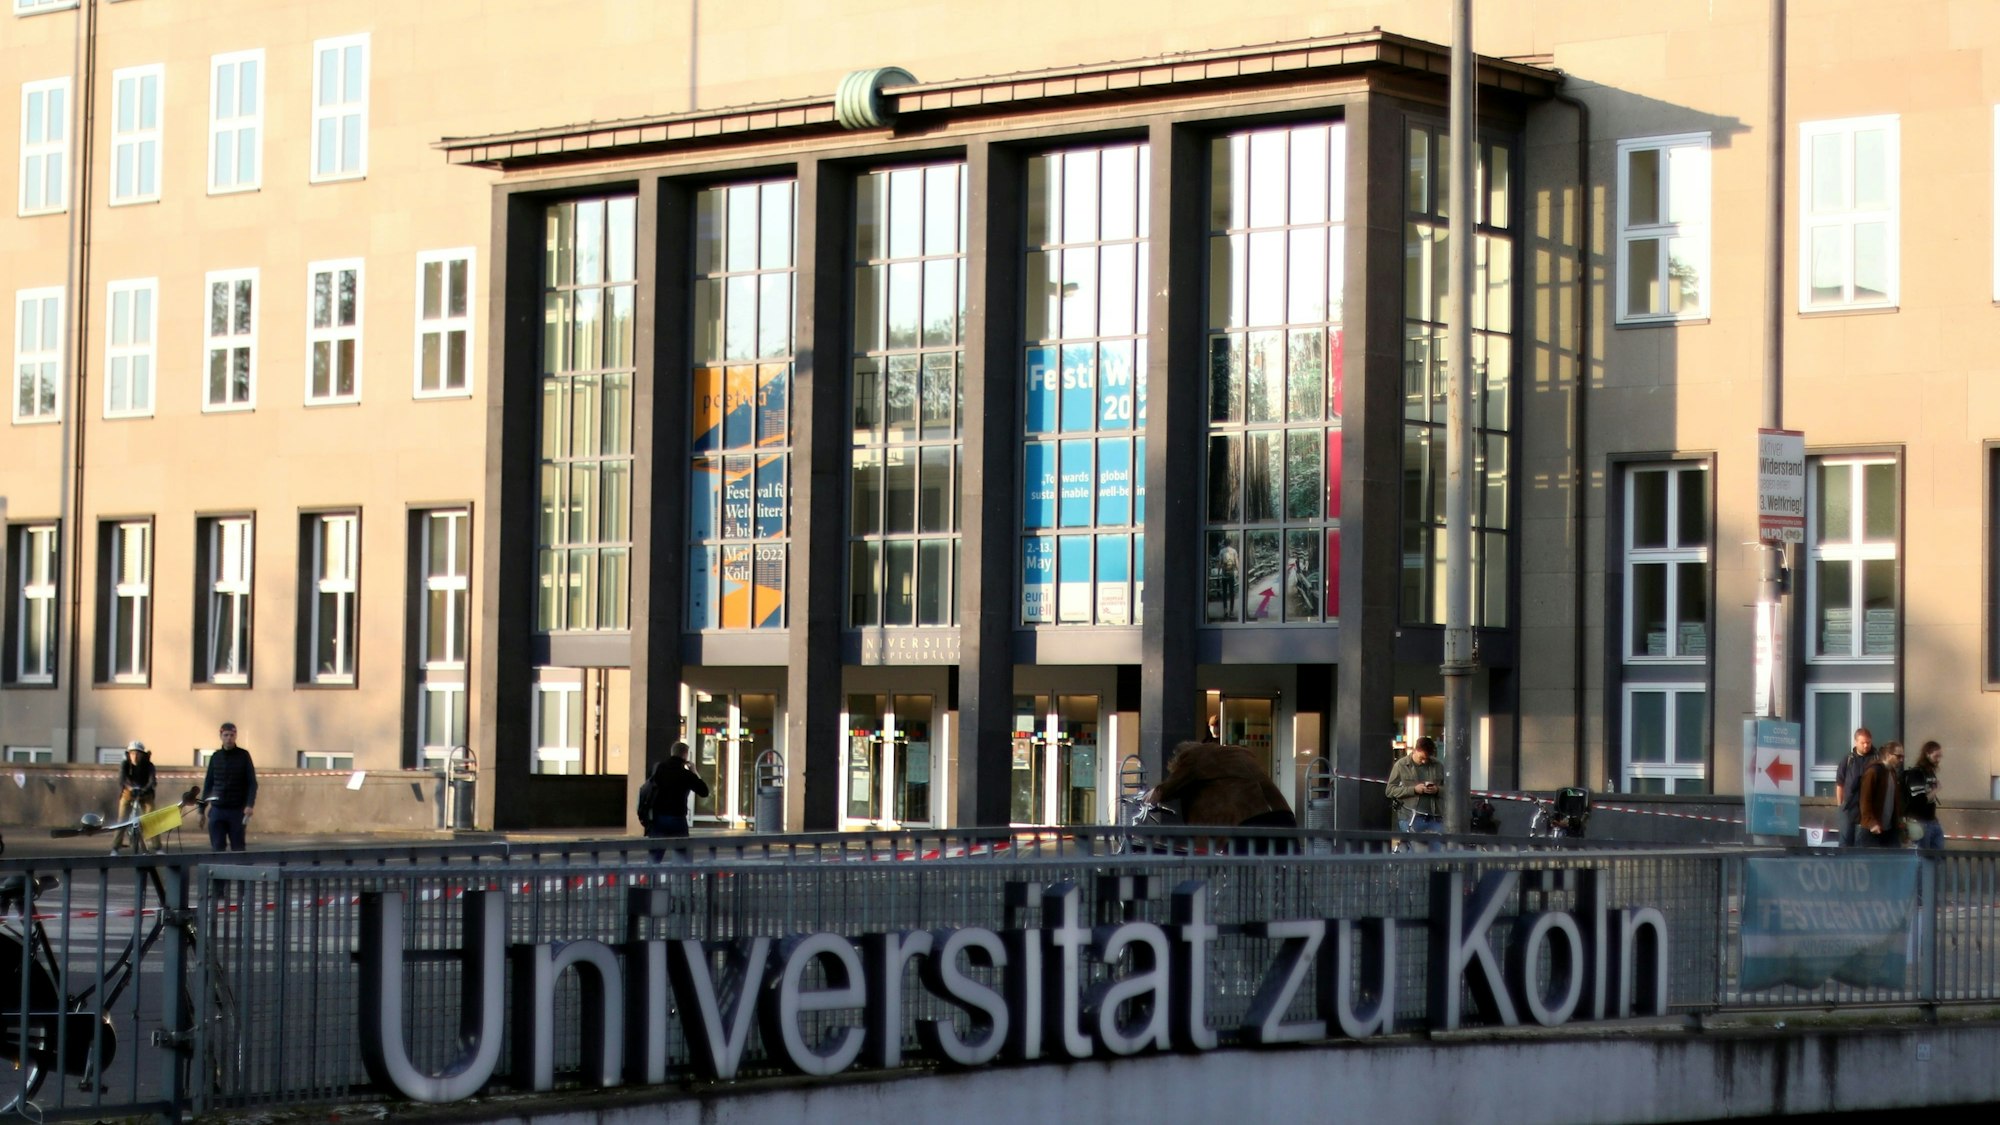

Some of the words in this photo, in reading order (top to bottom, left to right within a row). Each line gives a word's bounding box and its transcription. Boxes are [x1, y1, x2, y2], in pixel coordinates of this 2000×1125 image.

[1760, 457, 1802, 476] Widerstand
[1101, 470, 1128, 484] global
[1031, 487, 1089, 500] sustainable
[1099, 485, 1145, 497] well-bein
[1767, 495, 1802, 514] Weltkrieg!
[725, 525, 735, 538] 2.
[756, 549, 783, 561] 2022
[1026, 556, 1052, 572] May
[1027, 603, 1051, 616] well
[1799, 861, 1870, 893] COVID
[362, 876, 1218, 1101] Universität
[1244, 917, 1396, 1044] zu
[1432, 868, 1668, 1028] Köln
